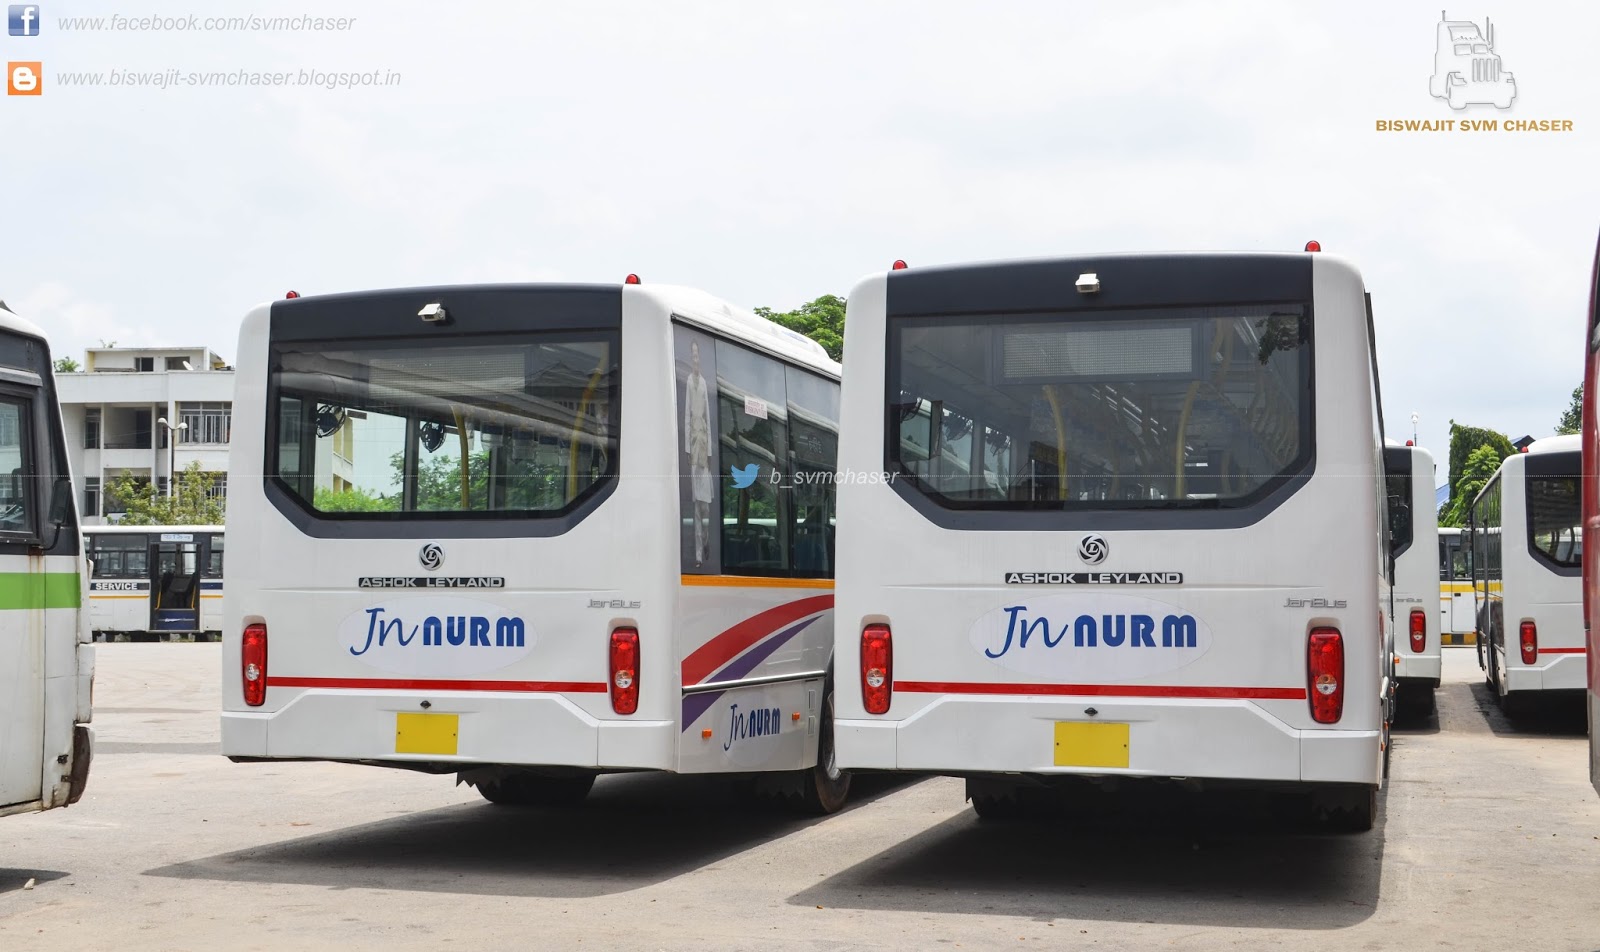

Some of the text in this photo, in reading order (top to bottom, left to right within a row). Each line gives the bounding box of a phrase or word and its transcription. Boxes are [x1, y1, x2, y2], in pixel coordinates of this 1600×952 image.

[360, 577, 503, 588] ASHOK LEYLAND
[1007, 573, 1181, 584] ASHOK LEYLAND
